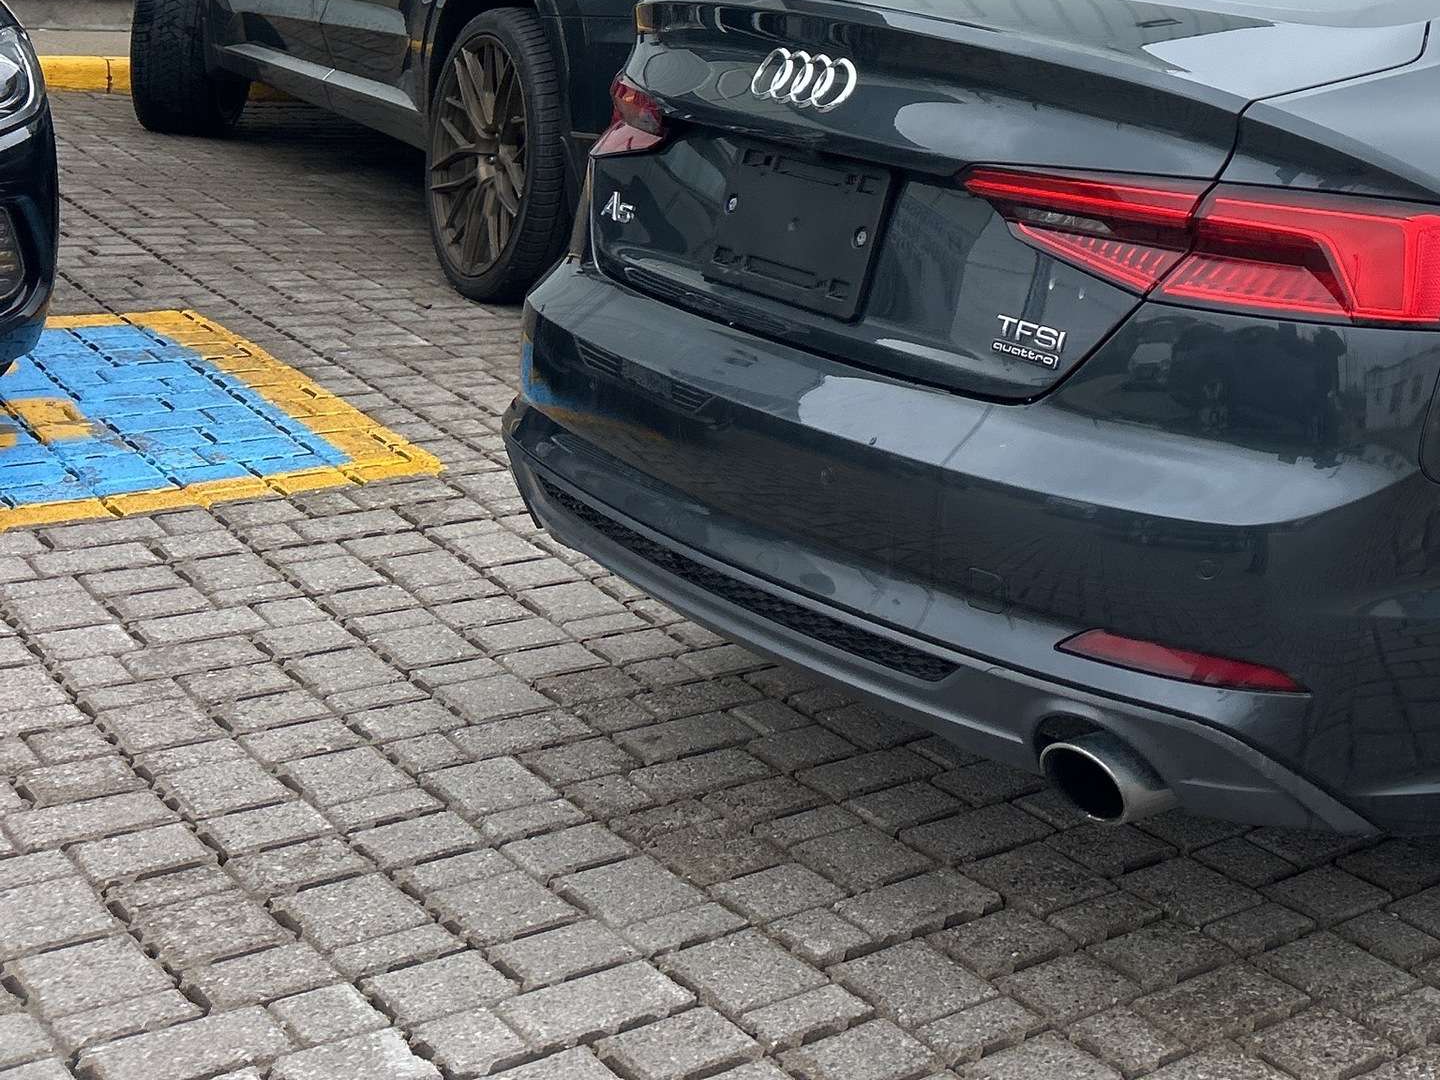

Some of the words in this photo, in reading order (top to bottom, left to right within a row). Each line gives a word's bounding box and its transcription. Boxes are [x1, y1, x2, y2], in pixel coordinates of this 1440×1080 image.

[600, 191, 635, 223] A5
[997, 314, 1066, 353] TFSI
[992, 341, 1055, 367] quattro
